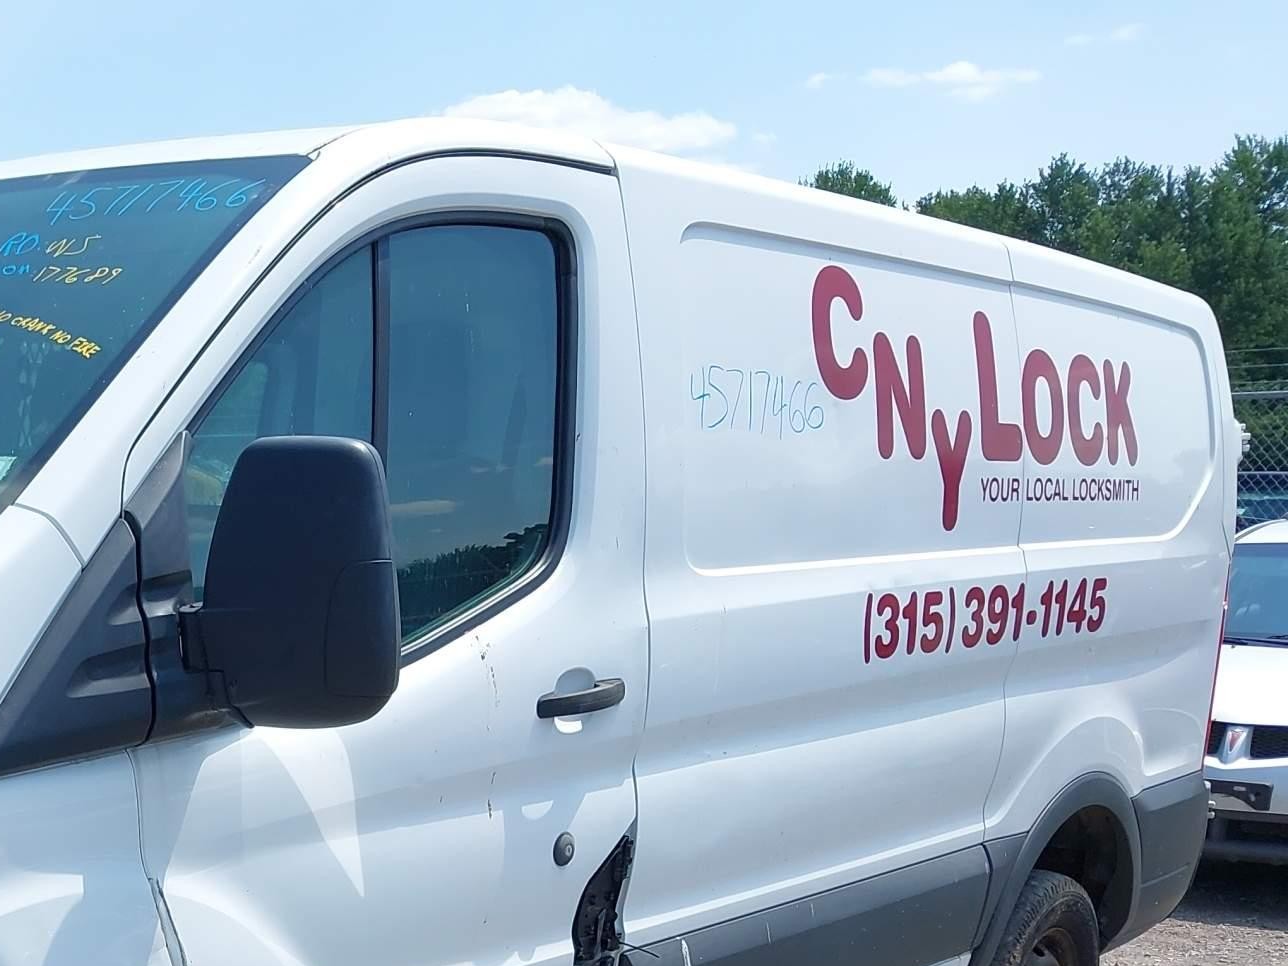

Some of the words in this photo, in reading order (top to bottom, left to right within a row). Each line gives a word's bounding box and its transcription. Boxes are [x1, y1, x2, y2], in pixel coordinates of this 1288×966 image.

[46, 178, 266, 226] 45717466
[10, 316, 57, 336] CRANK
[49, 329, 72, 344] NO
[690, 365, 825, 440] 45717466
[980, 477, 1020, 502] YOUR
[1026, 477, 1069, 502] LOCAL
[1072, 479, 1140, 501] LOCKSMITH
[863, 586, 956, 665] (315)
[961, 577, 1108, 649] 391-1145
